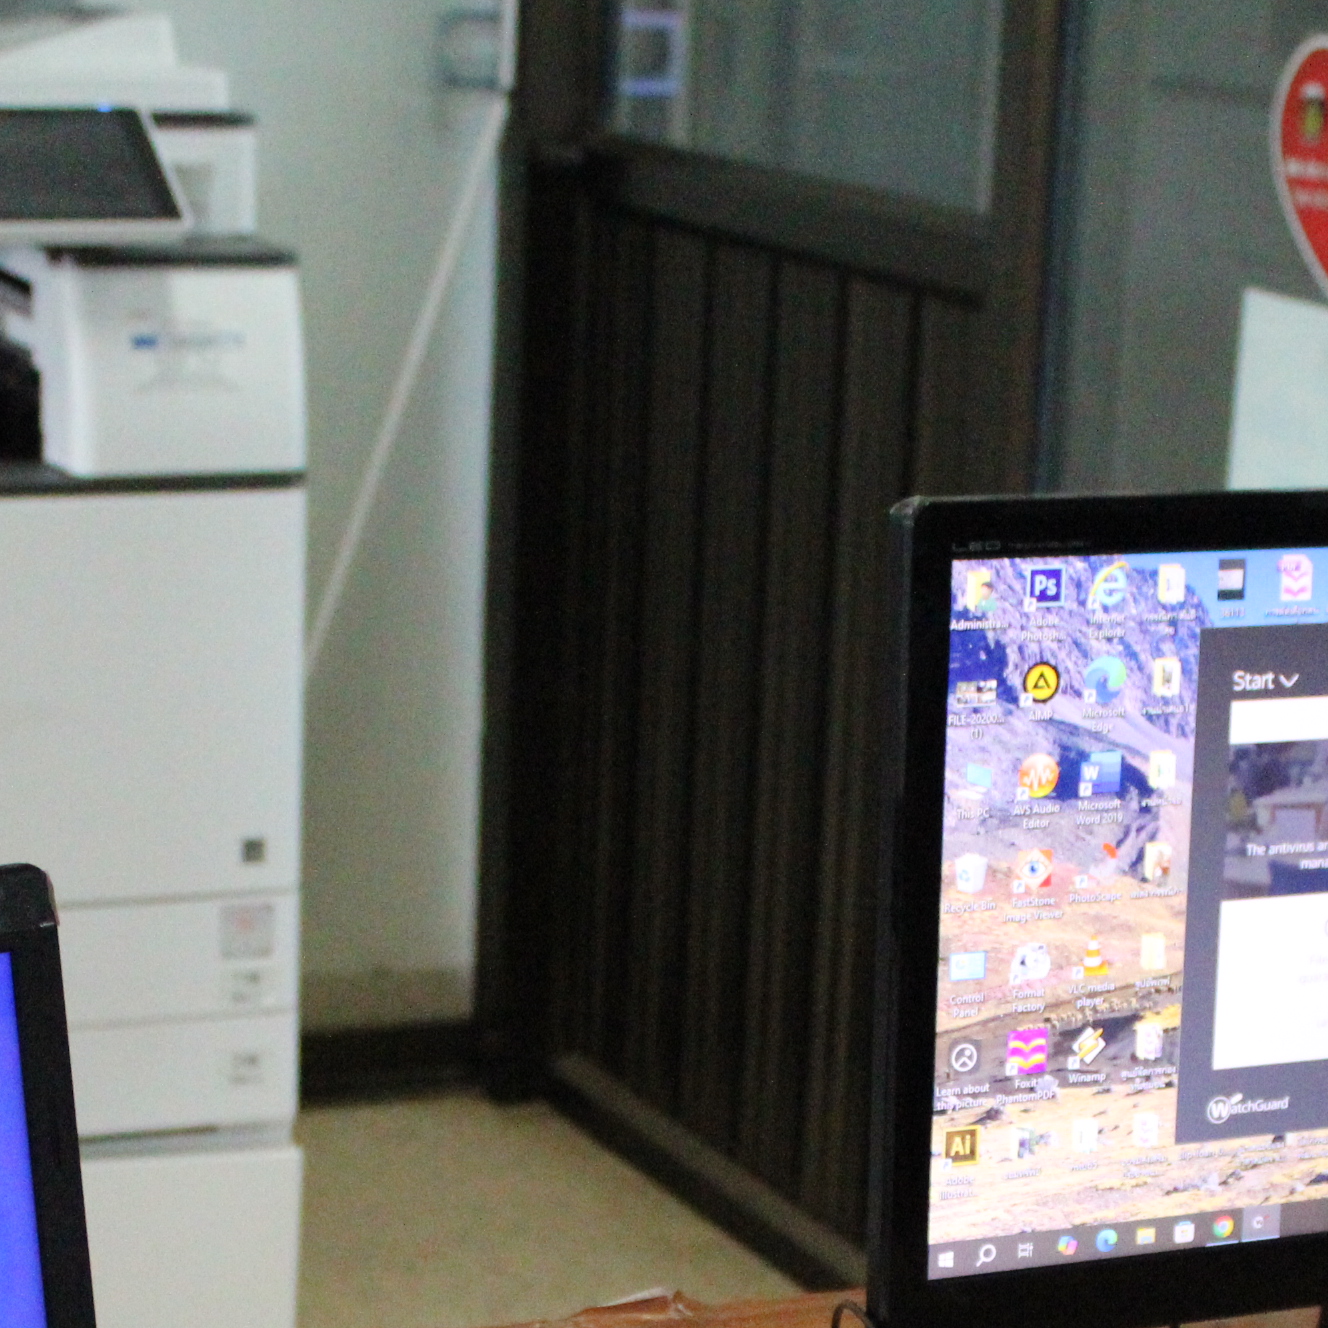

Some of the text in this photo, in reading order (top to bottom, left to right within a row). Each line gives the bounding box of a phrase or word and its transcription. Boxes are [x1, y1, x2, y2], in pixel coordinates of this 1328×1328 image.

[1034, 575, 1057, 597] Ps
[1232, 670, 1275, 692] Start
[1207, 1093, 1290, 1125] WatchGuard
[950, 1133, 971, 1158] Ai
